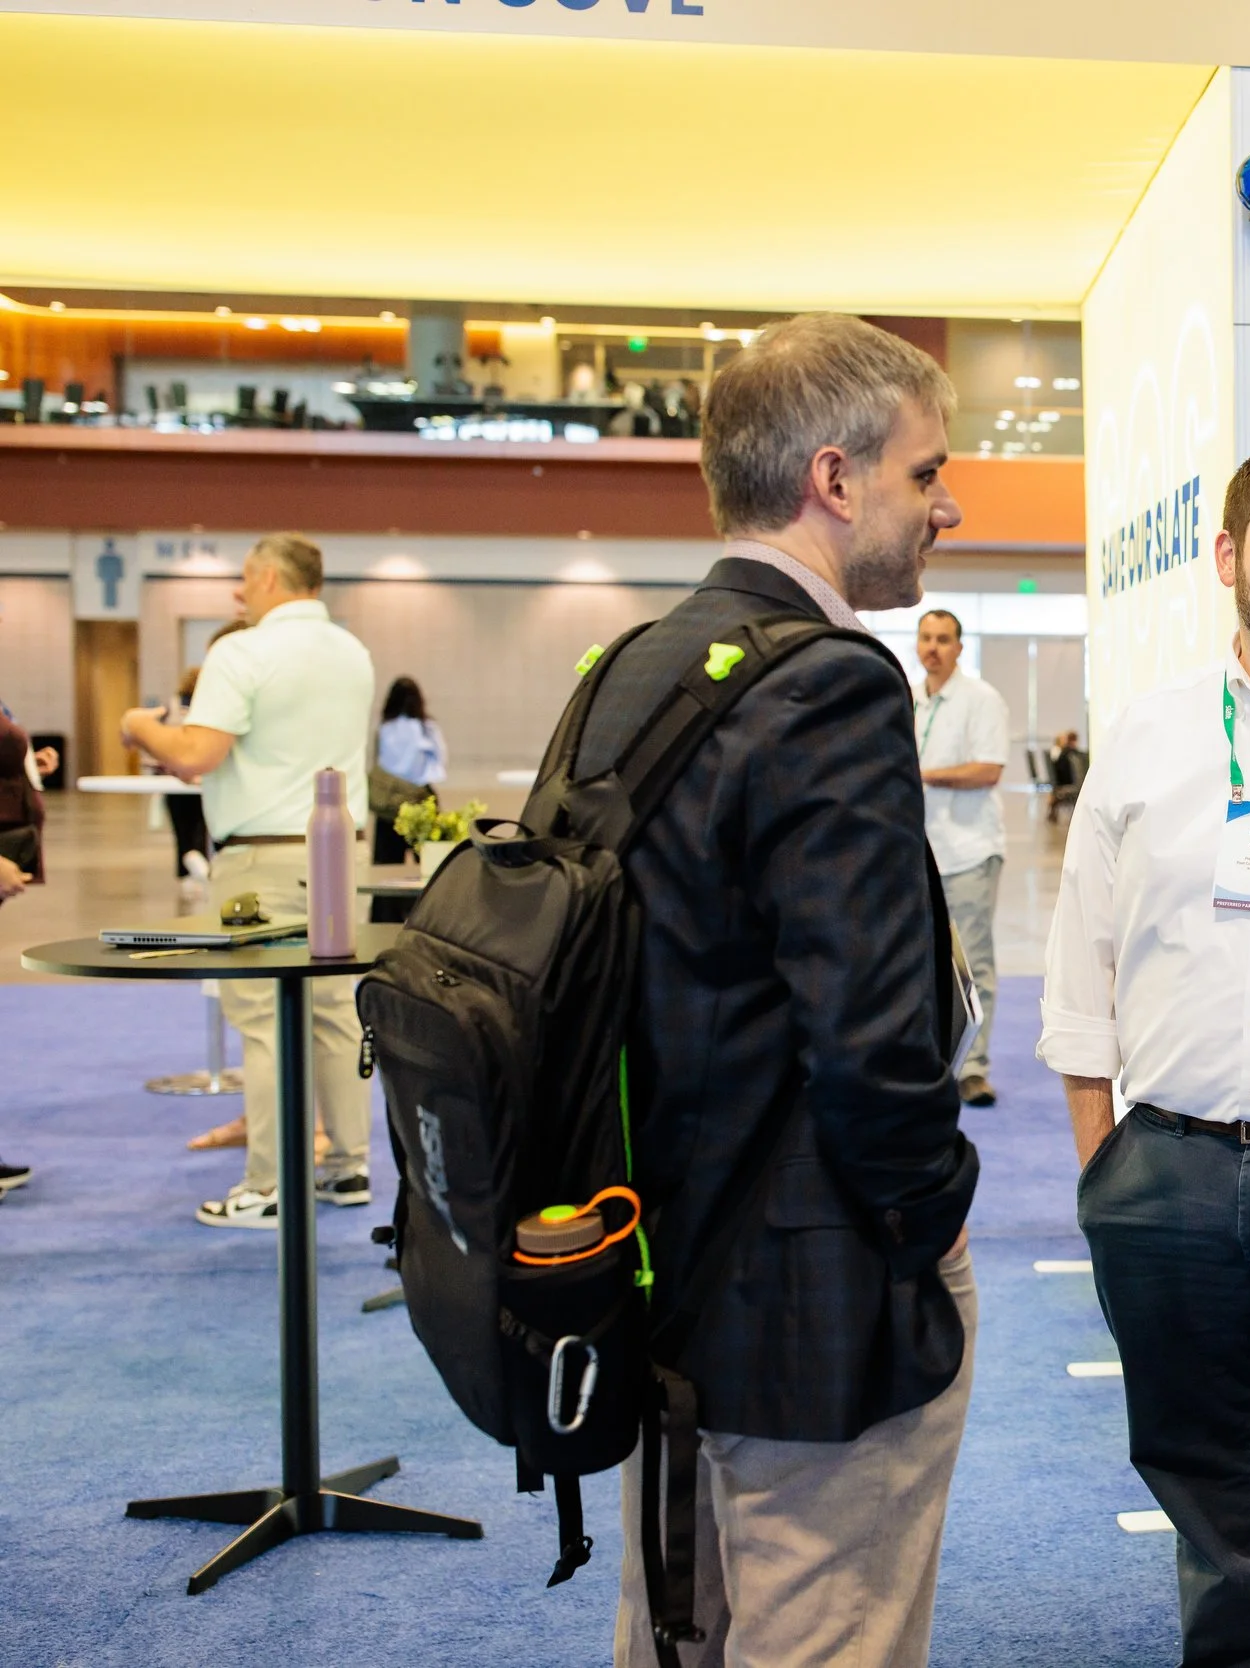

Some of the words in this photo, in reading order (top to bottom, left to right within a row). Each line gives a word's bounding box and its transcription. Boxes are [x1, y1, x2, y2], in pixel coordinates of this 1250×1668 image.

[1101, 523, 1126, 598] SAVE
[1128, 508, 1153, 588] OUR
[1155, 475, 1201, 576] SLATE
